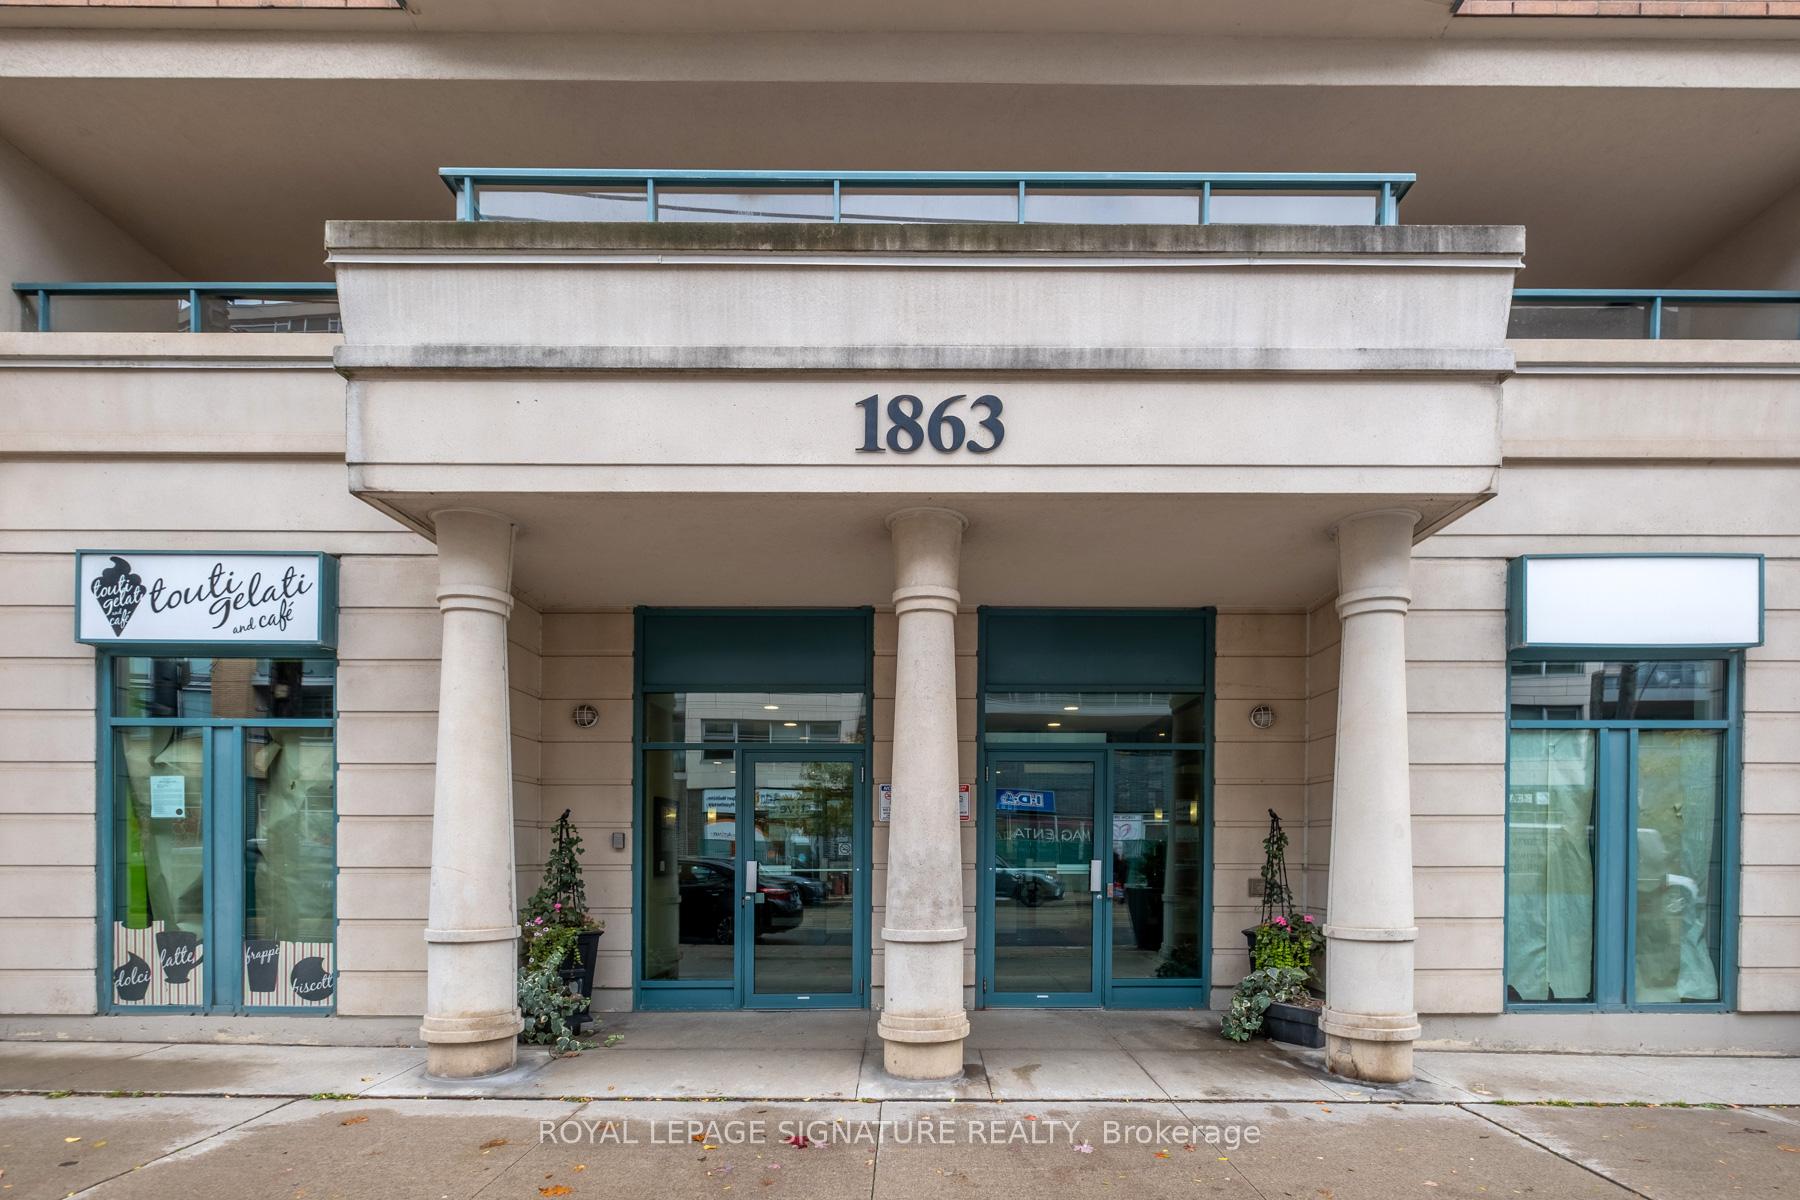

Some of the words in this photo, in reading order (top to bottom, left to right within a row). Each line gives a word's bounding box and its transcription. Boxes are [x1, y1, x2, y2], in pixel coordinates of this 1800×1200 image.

[855, 394, 1005, 452] 1863
[93, 574, 133, 599] touti
[149, 562, 243, 613] touti
[208, 566, 314, 629] gelati
[232, 617, 256, 634] and
[259, 598, 295, 632] café
[160, 946, 196, 968] latte
[114, 965, 151, 988] dolci
